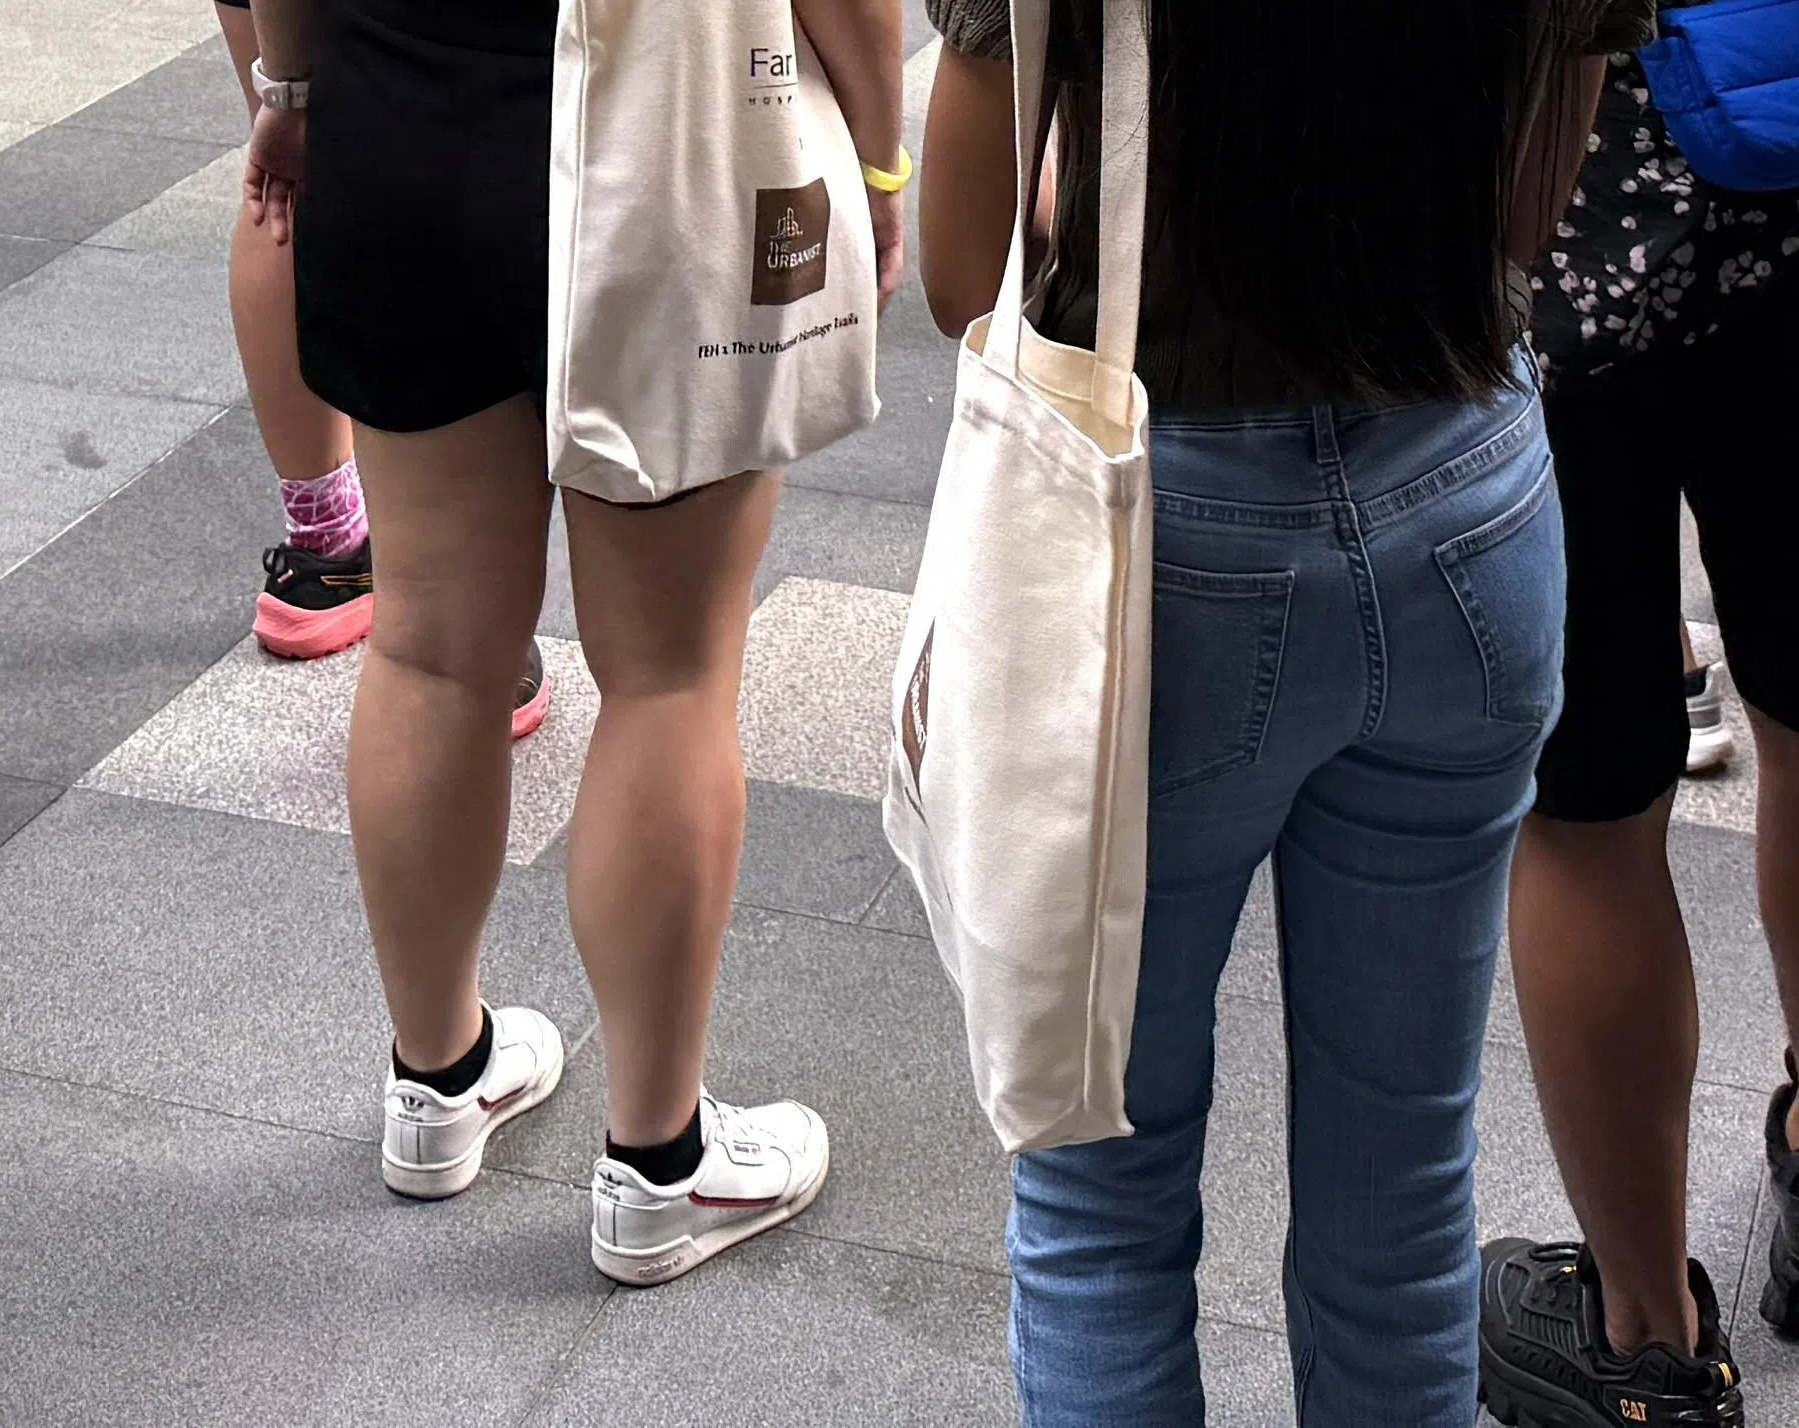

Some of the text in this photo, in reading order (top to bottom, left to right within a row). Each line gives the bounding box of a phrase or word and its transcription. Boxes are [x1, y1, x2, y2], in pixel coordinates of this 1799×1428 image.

[750, 48, 792, 78] Far
[732, 341, 755, 355] The
[1620, 1397, 1648, 1422] CAT
